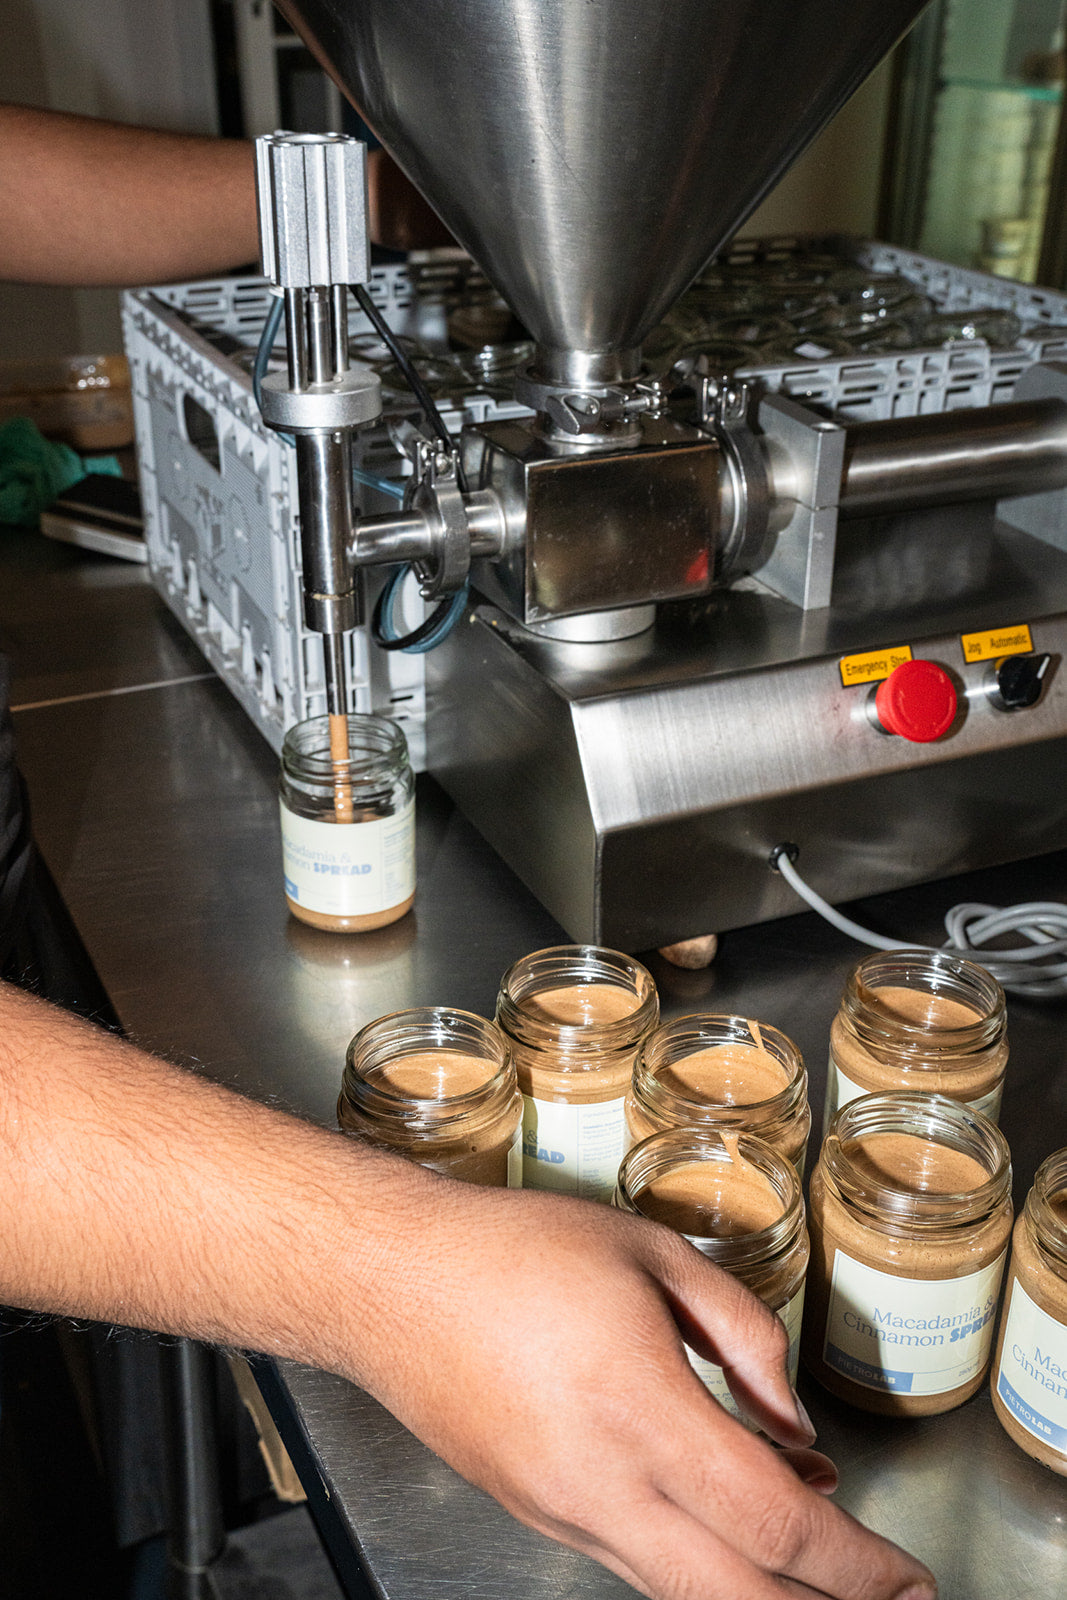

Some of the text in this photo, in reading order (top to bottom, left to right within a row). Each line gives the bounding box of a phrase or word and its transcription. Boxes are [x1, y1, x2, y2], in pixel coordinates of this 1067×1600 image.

[990, 633, 1028, 649] Automatic
[845, 660, 888, 677] Emergency
[313, 861, 373, 876] SPREAD
[527, 1129, 538, 1144] &
[873, 1294, 993, 1330] Macadamia &
[843, 1311, 945, 1347] Cinnamon
[1005, 1388, 1053, 1435] PIETROLAB
